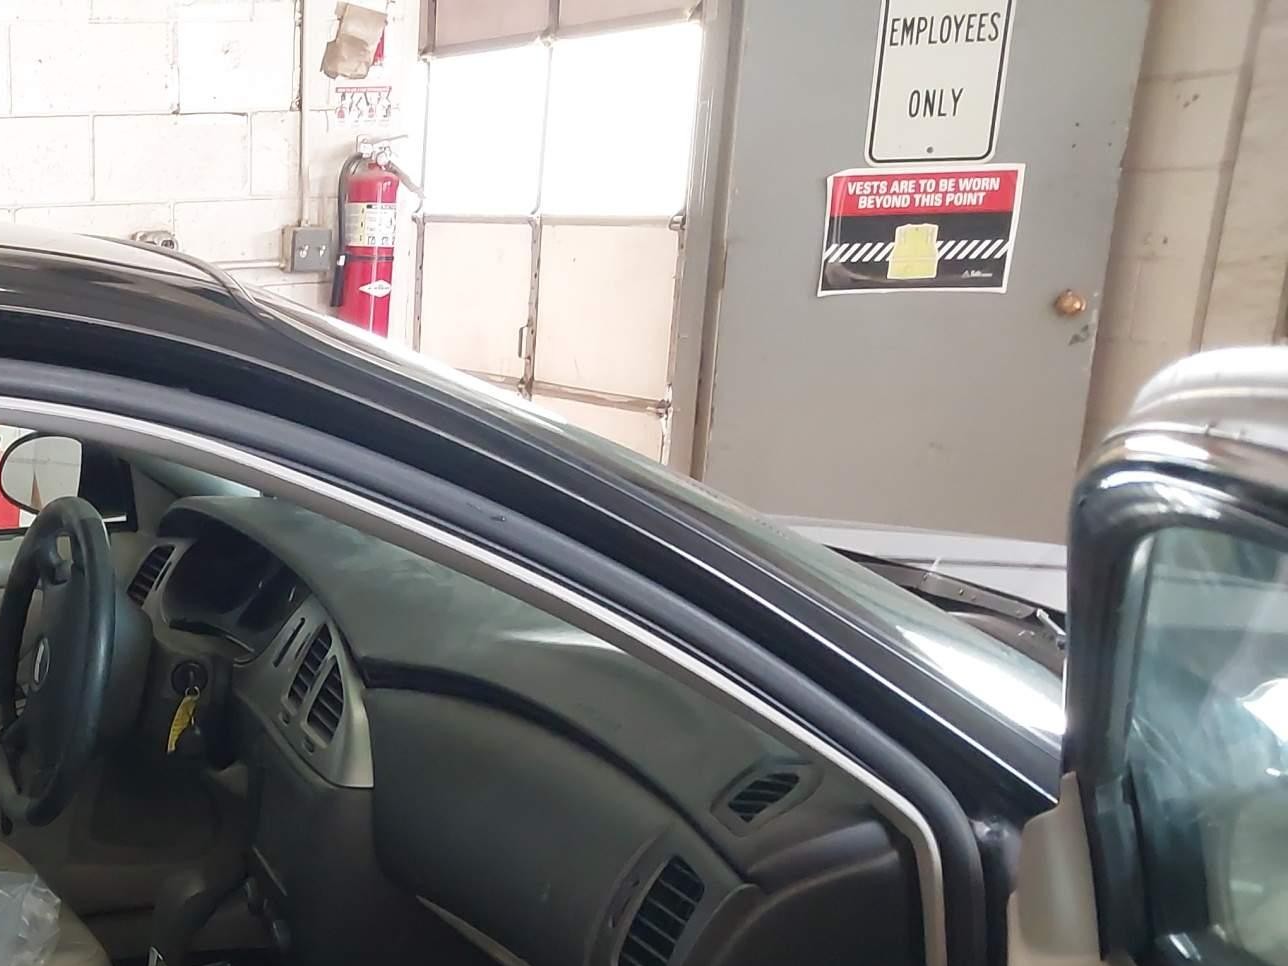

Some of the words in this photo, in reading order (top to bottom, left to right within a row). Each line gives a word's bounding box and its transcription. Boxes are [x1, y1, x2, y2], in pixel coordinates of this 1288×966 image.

[889, 12, 1001, 46] EMPLOYEES
[908, 88, 964, 117] ONLY
[847, 180, 888, 195] VESTS
[890, 179, 916, 194] ARE
[919, 179, 936, 192] TO
[938, 178, 957, 192] BE
[958, 177, 1001, 191] WORN
[858, 194, 910, 209] BEYOND
[913, 193, 942, 207] THIS
[945, 192, 986, 206] POINT
